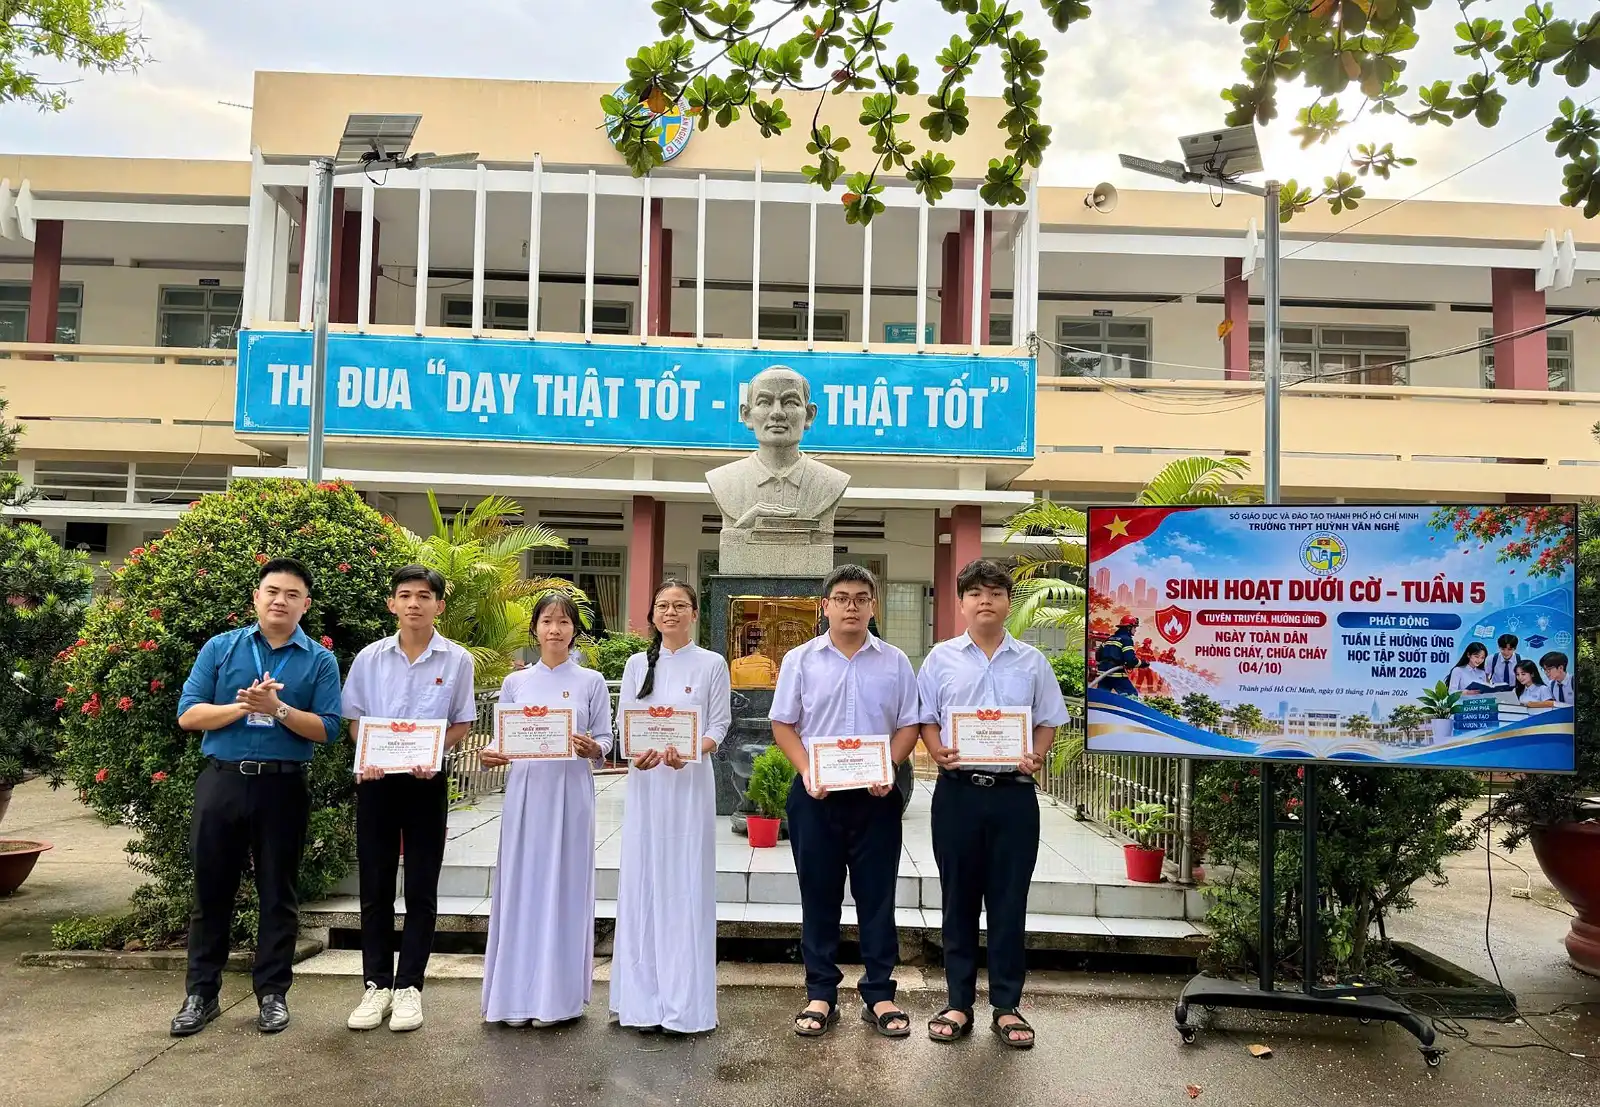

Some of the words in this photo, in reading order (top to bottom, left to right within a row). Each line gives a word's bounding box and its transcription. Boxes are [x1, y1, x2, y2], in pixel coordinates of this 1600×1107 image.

[267, 363, 313, 406] TH
[337, 365, 412, 410] ĐUA
[427, 358, 520, 423] “DẠY
[533, 367, 624, 427] THẬT
[635, 364, 700, 421] TỐT
[823, 376, 913, 436] THẬT
[924, 372, 1009, 429] TỐT”
[1241, 511, 1261, 520] GIÁO
[1262, 513, 1278, 521] DỤC
[1279, 511, 1290, 520] VÀ
[1291, 511, 1308, 520] ĐÀO
[1310, 513, 1325, 521] TẠO
[1326, 511, 1350, 520] THÀNH
[1352, 510, 1369, 520] PHỐ
[1370, 510, 1382, 520] HỒ
[1383, 511, 1397, 520] CHÍ
[1399, 512, 1420, 520] MINH
[1249, 521, 1286, 531] TRƯỜNG
[1289, 522, 1314, 531] THPT
[1316, 520, 1349, 531] HUỲNH
[1352, 521, 1371, 531] VĂN
[1374, 521, 1400, 533] NGHỆ
[1165, 579, 1218, 600] SINH
[1224, 579, 1283, 605] HOẠT
[1289, 575, 1344, 601] DƯỚI
[1350, 576, 1383, 602] CỜ
[1401, 572, 1463, 603] TUẦN
[1470, 582, 1486, 603] 5
[1204, 612, 1231, 623] TUYÊN
[1271, 612, 1300, 624] HƯỞNG
[1302, 613, 1320, 624] ỨNG
[1369, 615, 1397, 626] PHÁT
[1399, 615, 1430, 628] ĐỘNG
[1215, 629, 1246, 643] NGÀY
[1249, 630, 1280, 643] TOÀN
[1283, 630, 1308, 644] DÂN
[1374, 631, 1386, 647] LỄ
[1431, 634, 1454, 648] ỨNG
[1195, 644, 1231, 657] PHÒNG
[1234, 644, 1264, 659] CHÁY,
[1266, 646, 1296, 659] CHỮA
[1299, 646, 1328, 659] CHÁY
[1347, 650, 1371, 664] HỌC
[1373, 648, 1395, 664] TẬP
[1398, 648, 1428, 663] SUỐT
[1430, 651, 1450, 664] ĐỜI
[1238, 661, 1282, 675] (04/10)
[1371, 664, 1396, 678] NĂM
[1399, 667, 1427, 679] 2026
[1238, 684, 1259, 692] Thành
[1260, 684, 1273, 693] phố
[1285, 685, 1296, 693] Chí
[1298, 686, 1316, 694] Minh,
[1318, 687, 1334, 696] ngày
[1345, 687, 1364, 697] tháng
[1375, 688, 1390, 696] năm
[1391, 689, 1408, 697] 2026
